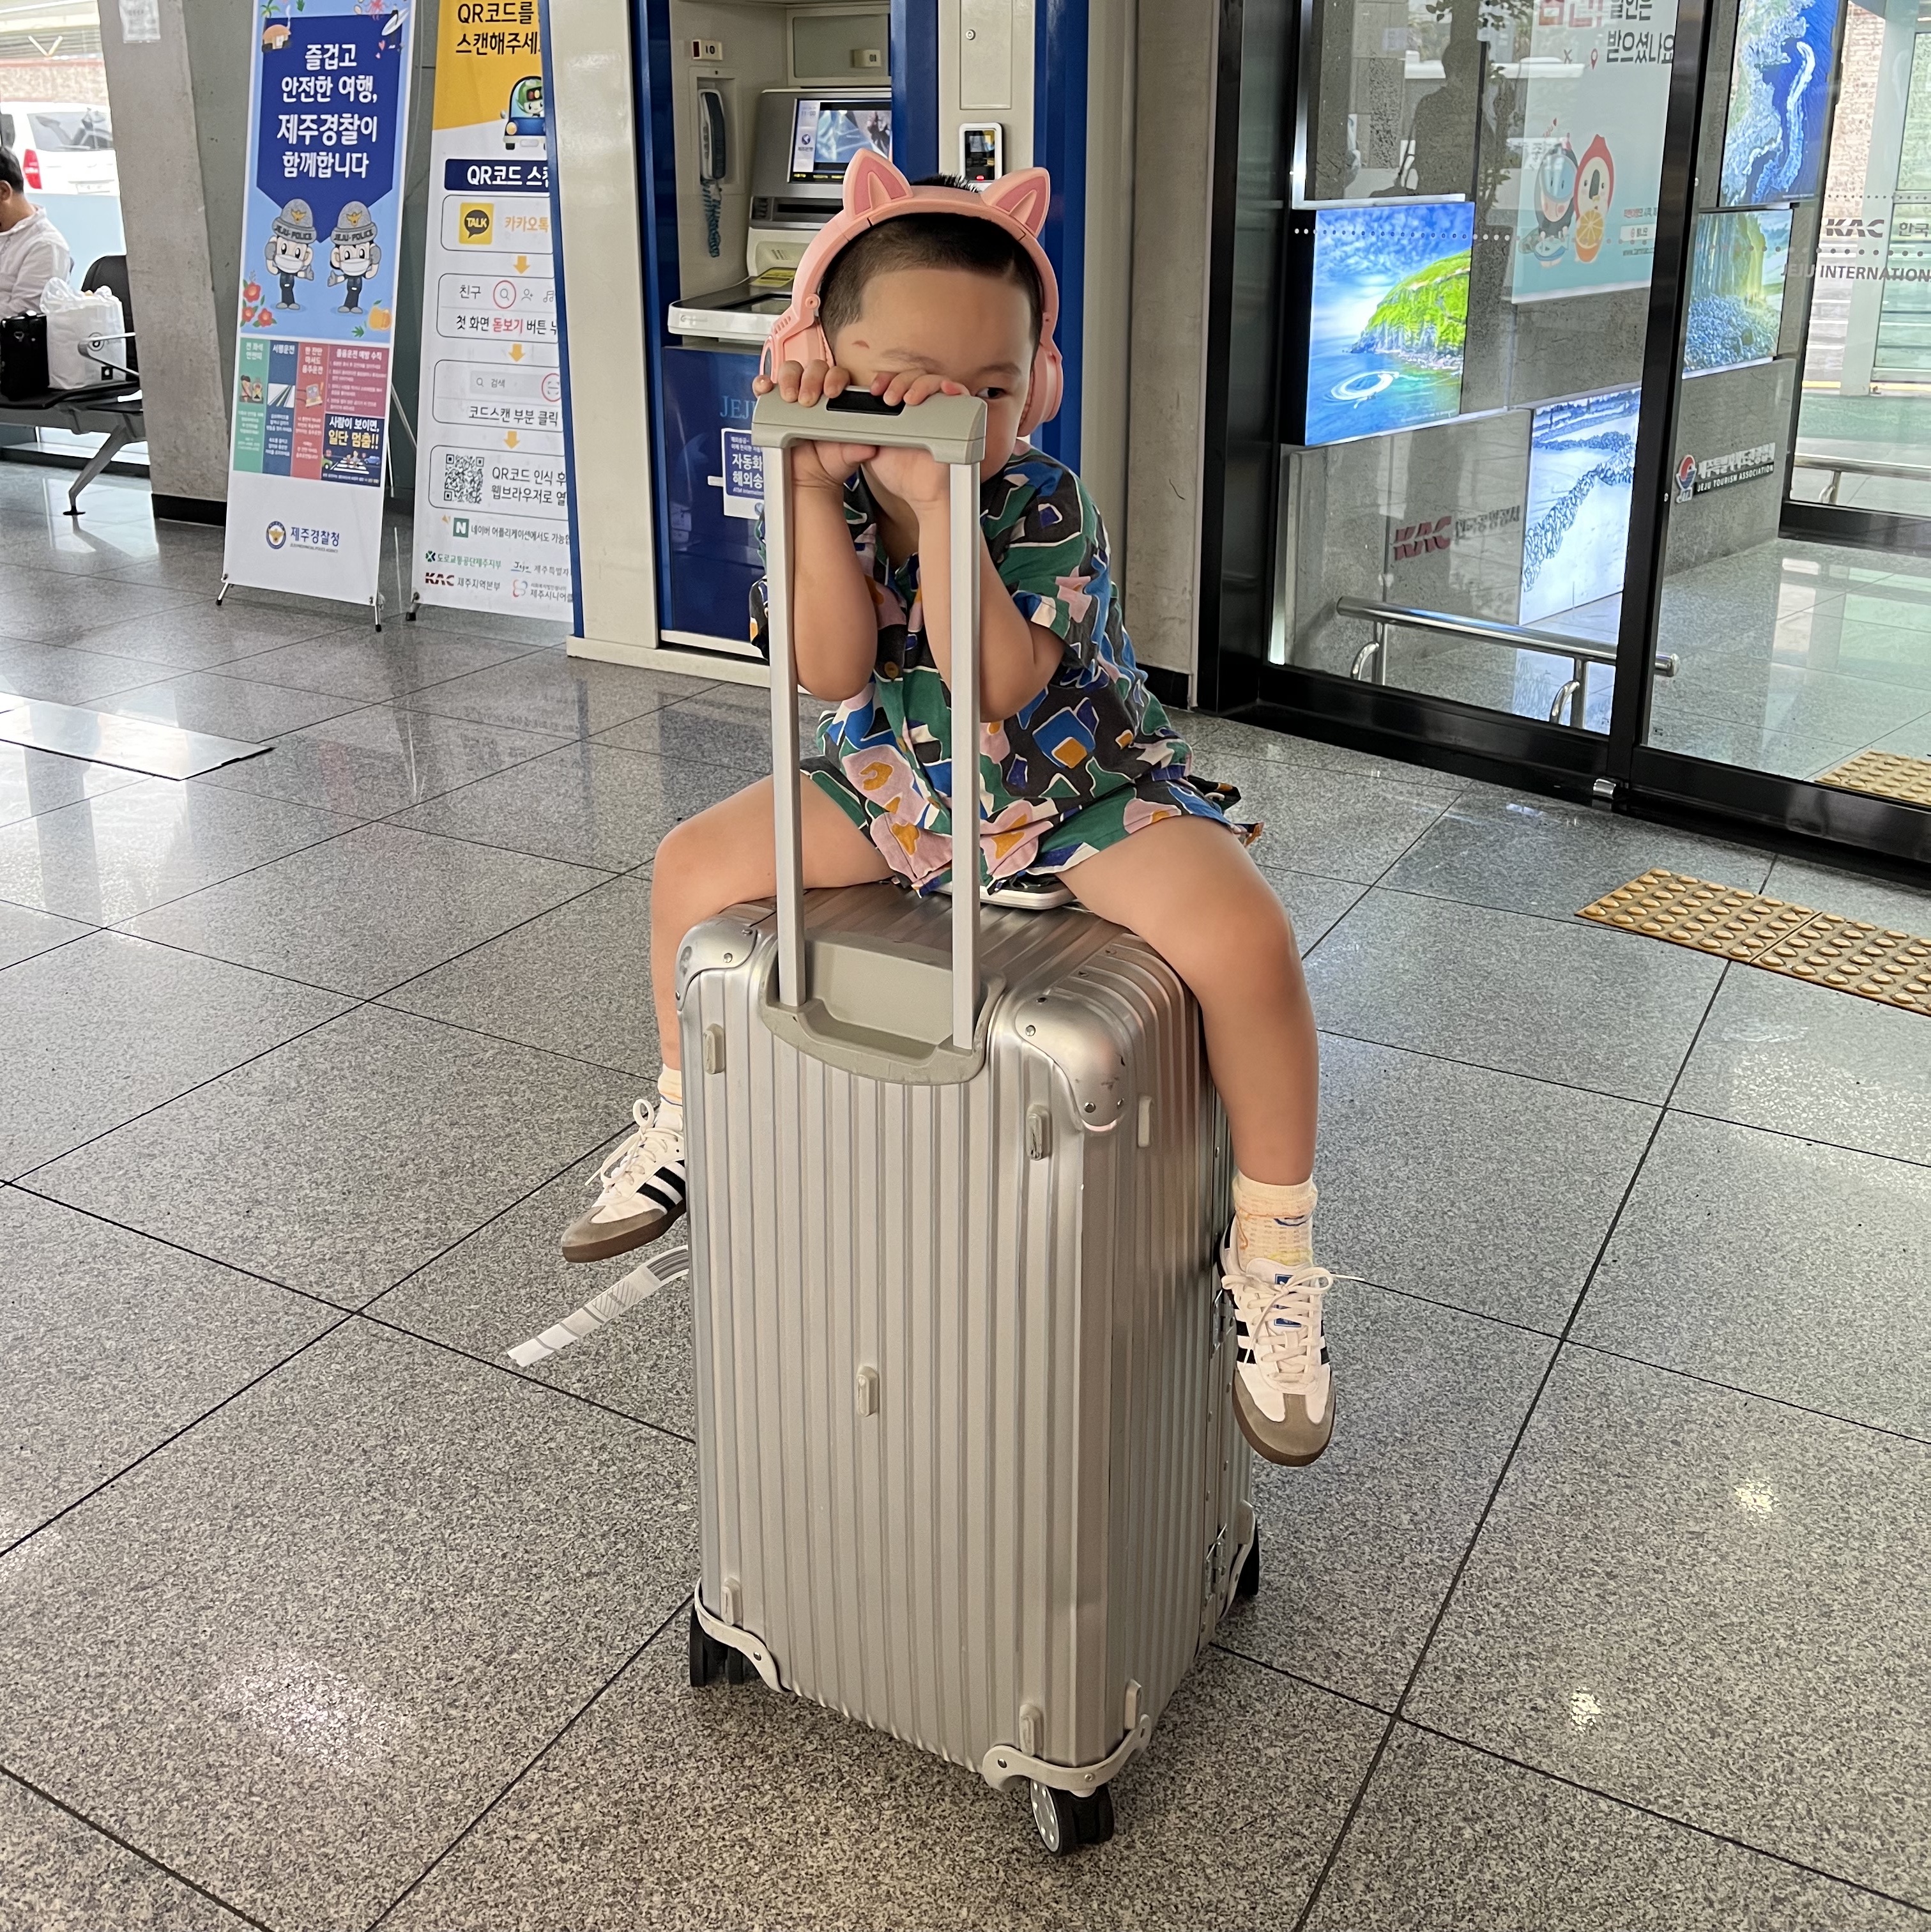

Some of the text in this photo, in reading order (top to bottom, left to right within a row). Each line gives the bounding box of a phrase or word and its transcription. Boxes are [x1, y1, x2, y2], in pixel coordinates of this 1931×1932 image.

[458, 2, 534, 24] QR코드를
[455, 31, 541, 55] 스캔해주세
[705, 45, 715, 54] 10
[1607, 29, 1675, 64] 받으셨나요
[305, 43, 357, 71] 즐겁고
[281, 75, 378, 103] 안전한 여행,
[277, 113, 378, 146] 제주경찰이
[282, 151, 369, 179] 함께합니다
[467, 165, 523, 185] QR코드
[466, 217, 487, 228] TALK
[505, 216, 549, 233] 카카오톡
[1826, 218, 1930, 238] KAC 한국
[1780, 263, 1815, 279] JEJU
[459, 284, 482, 300] 친구
[456, 315, 466, 330] 첫
[469, 316, 489, 332] 화면
[526, 319, 547, 335] 버튼
[491, 378, 506, 389] 검색
[469, 406, 558, 427] 코드스캔 부분 클릭
[720, 395, 756, 420] JEJ
[329, 416, 380, 433] 사람이 보이면,
[328, 429, 379, 450] 일단 멈춤!!
[732, 453, 763, 472] 자동화
[492, 467, 567, 487] QR코드 인식 후
[732, 470, 764, 489] 해외송
[1697, 464, 1773, 493] JEJU TOURISM ASSOCIATION
[491, 485, 553, 505] 웹브라우저로
[290, 526, 340, 547] 제주경찰청
[455, 521, 466, 534] N
[471, 525, 491, 536] 네이버
[492, 527, 550, 542] 어플리케이션에서도
[1393, 516, 1452, 561] KAC
[425, 572, 501, 592] KAC 제주지역본부
